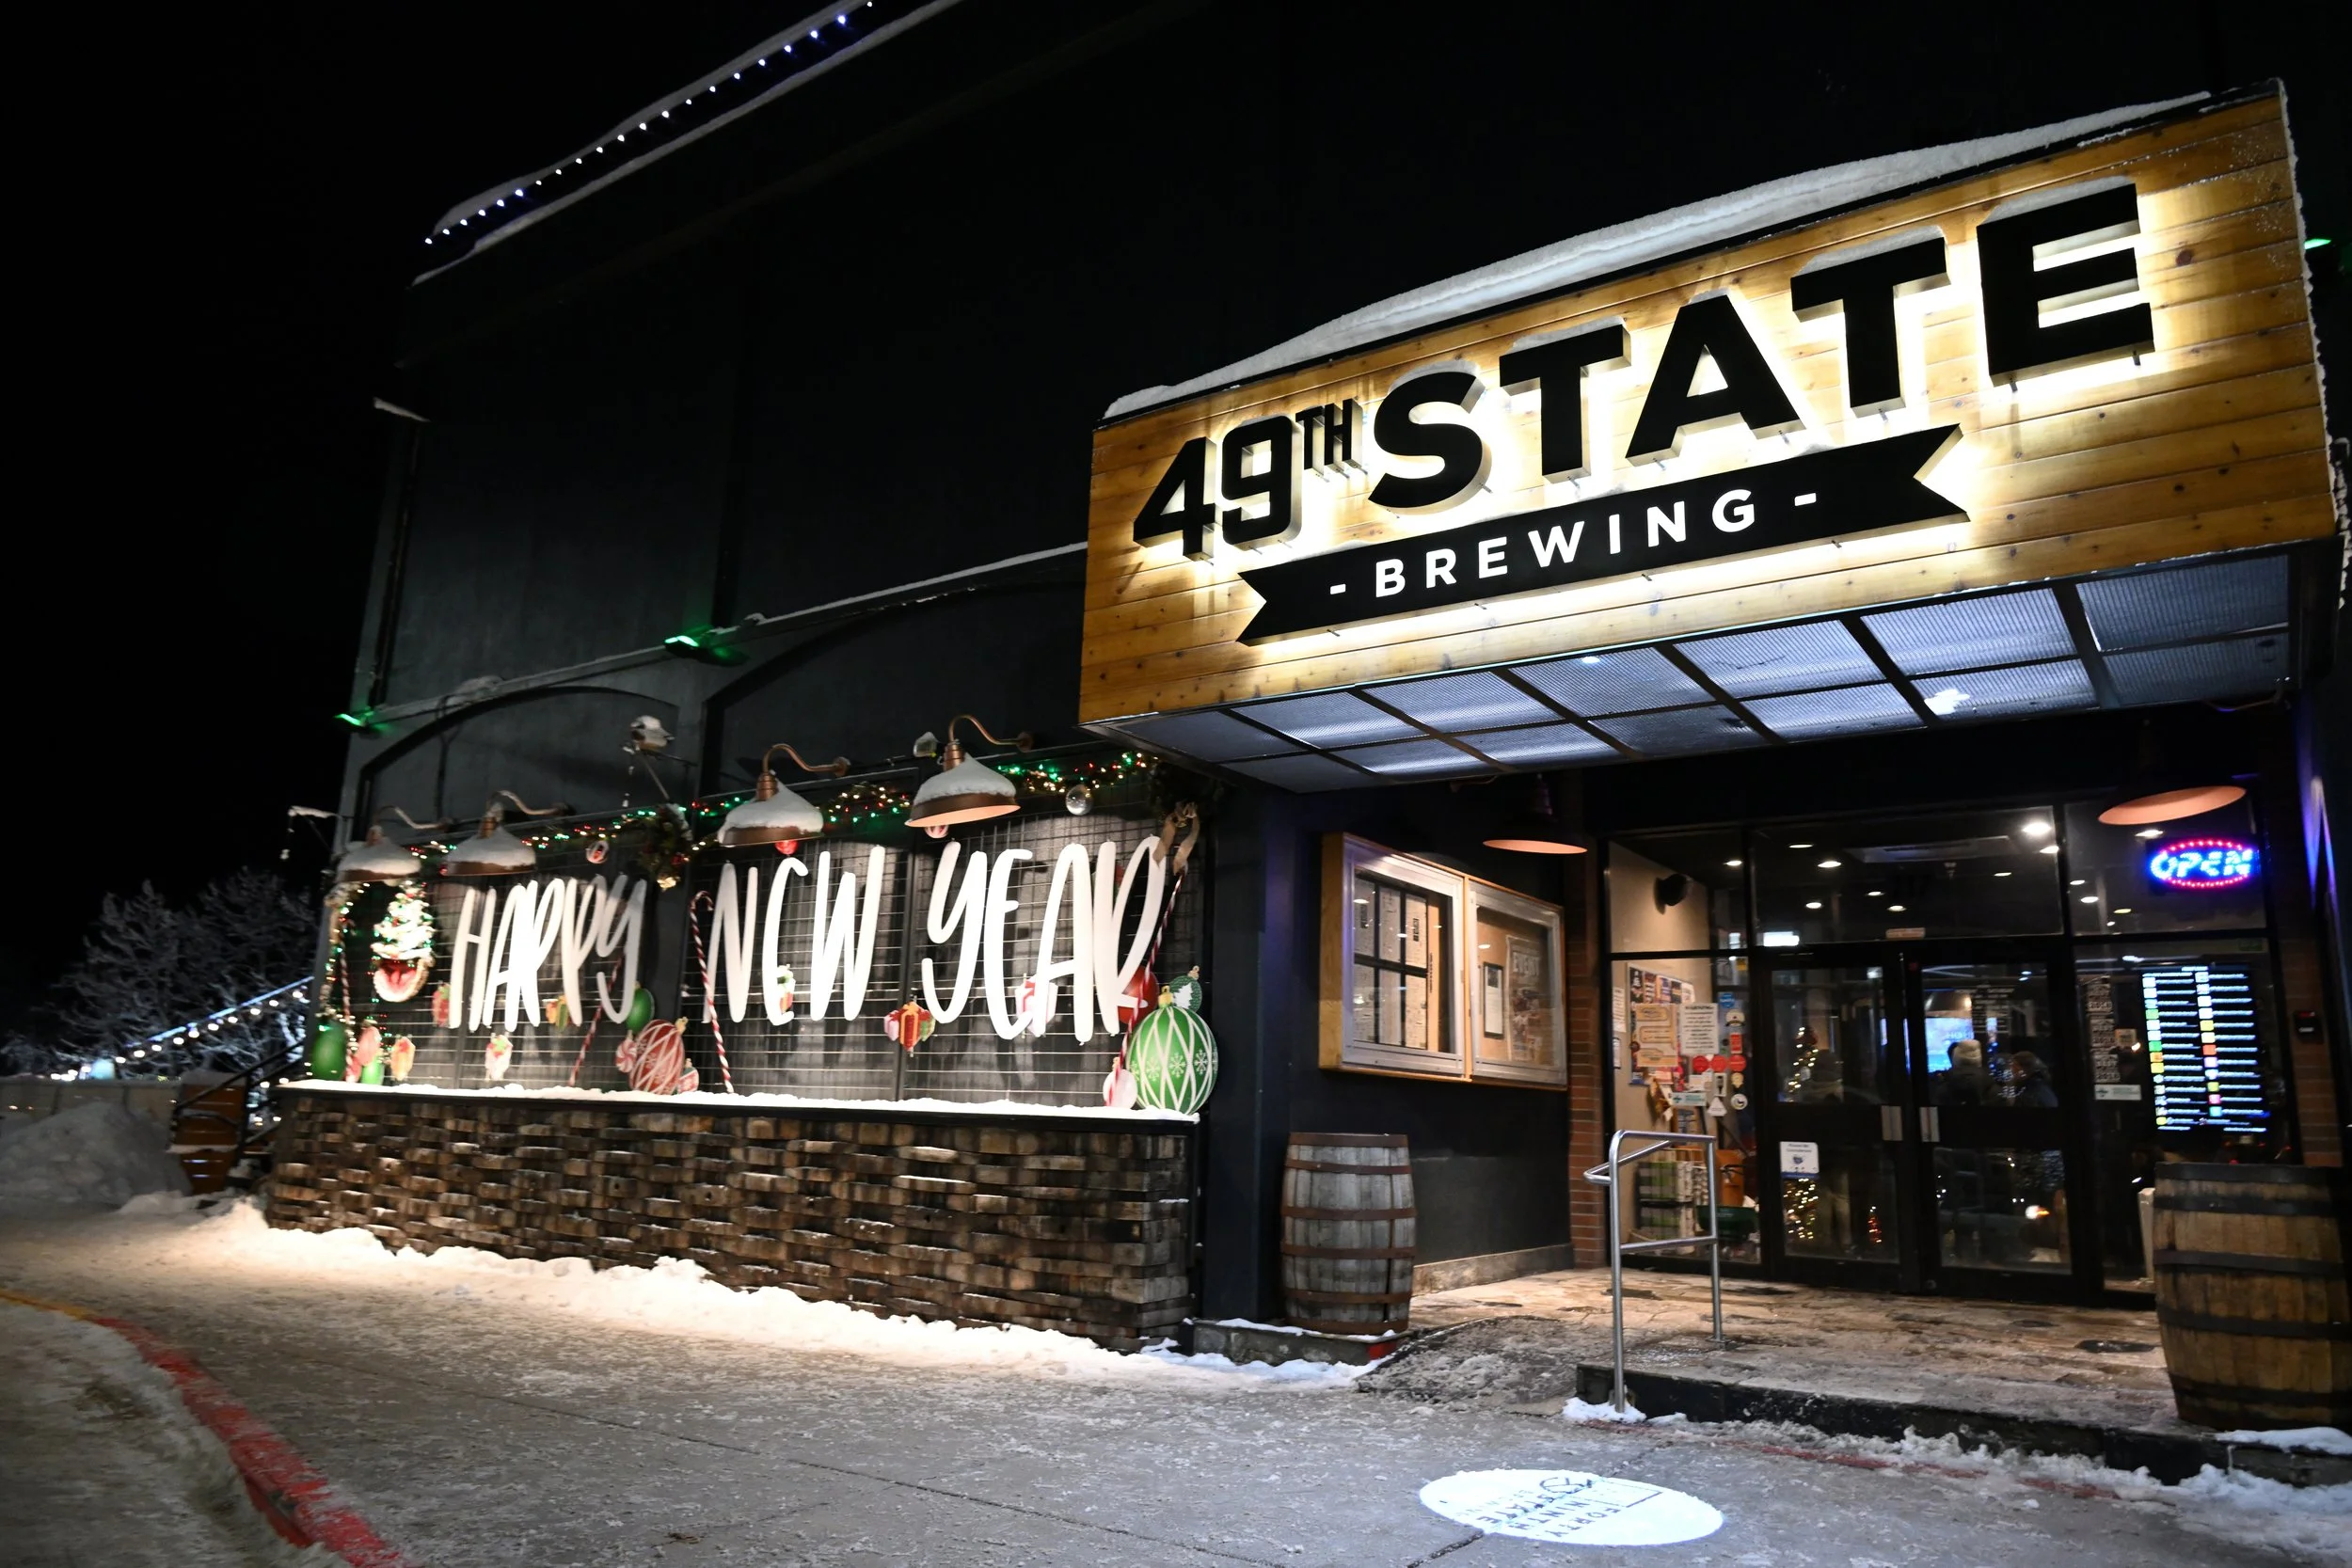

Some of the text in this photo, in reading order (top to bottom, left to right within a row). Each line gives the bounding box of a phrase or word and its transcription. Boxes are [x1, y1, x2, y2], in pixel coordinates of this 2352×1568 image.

[1133, 181, 2154, 559] 49TH STATE
[1375, 488, 1756, 598] BREWING
[2151, 849, 2253, 879] OPEN
[449, 875, 646, 1035] HAPPY
[704, 845, 886, 1024] NEW
[920, 835, 1168, 1044] YEAR
[1544, 1507, 1621, 1538] FORTY
